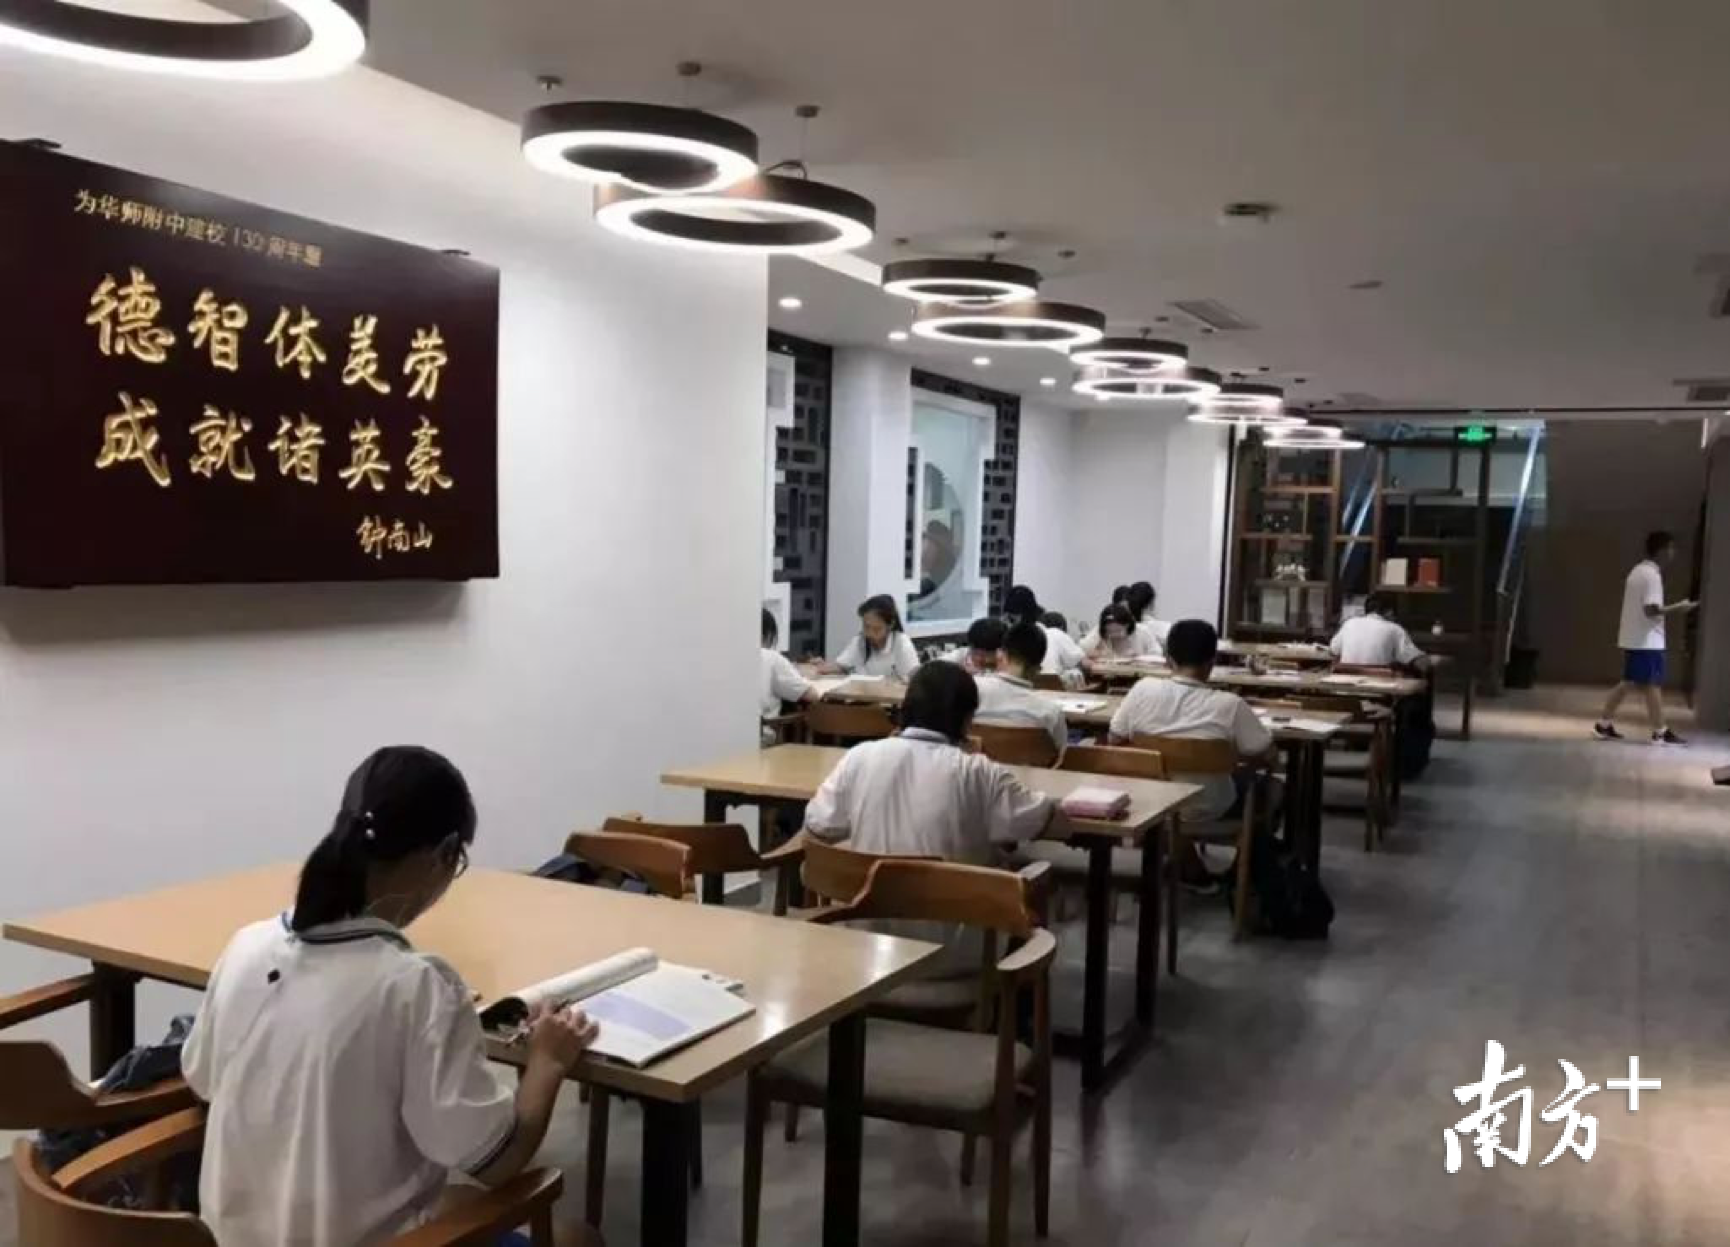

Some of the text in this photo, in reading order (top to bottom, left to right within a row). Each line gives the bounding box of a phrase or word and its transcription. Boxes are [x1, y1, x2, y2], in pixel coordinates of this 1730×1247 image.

[86, 267, 448, 400] 德智体美劳
[95, 391, 453, 495] 成就诸英豪
[356, 515, 433, 560] 钟南山
